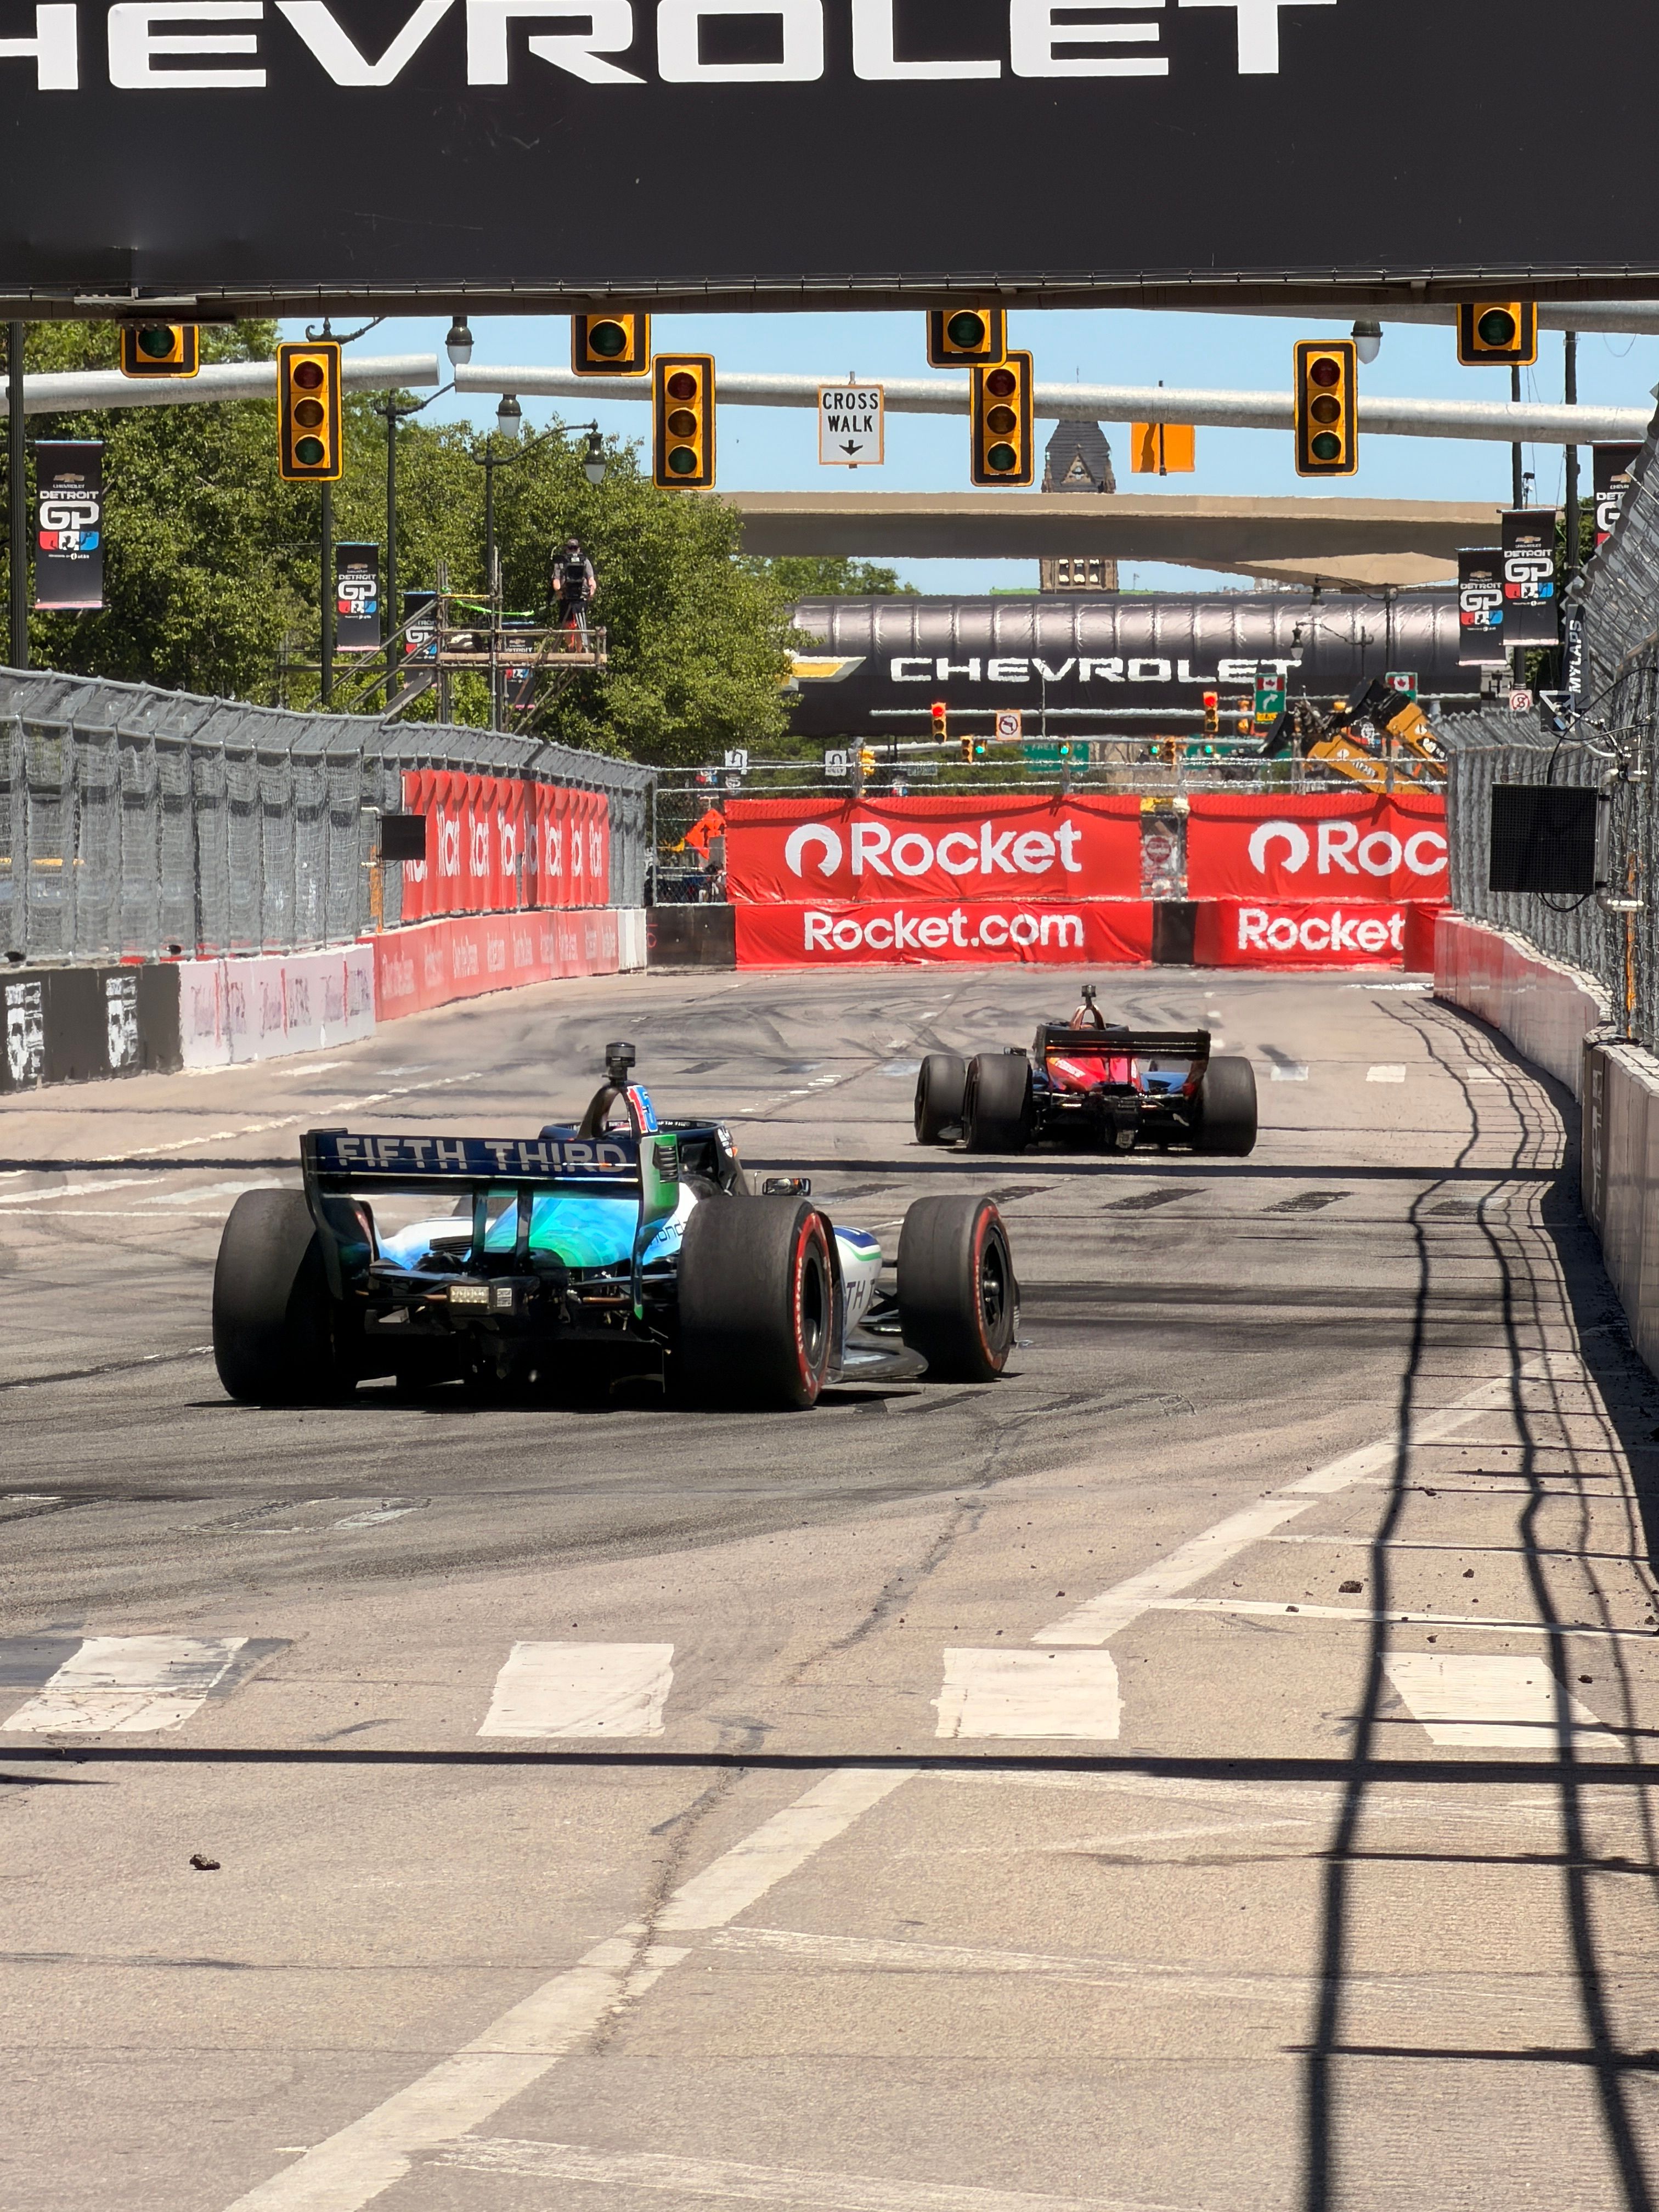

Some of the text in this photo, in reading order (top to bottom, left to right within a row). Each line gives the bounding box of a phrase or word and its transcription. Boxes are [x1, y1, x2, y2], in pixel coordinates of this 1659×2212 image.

[822, 392, 879, 410] CROSS
[827, 415, 873, 432] WALK
[40, 490, 99, 499] DETROIT
[40, 500, 100, 530] GP
[1504, 549, 1553, 558] DETROIT
[1505, 557, 1554, 582] GP
[338, 580, 377, 600] GP
[1460, 589, 1503, 612] GP
[1568, 619, 1582, 693] MYLAPS
[890, 657, 1302, 682] CHEVROLET
[851, 820, 1082, 877] Rocket
[1318, 820, 1448, 876] Roc
[804, 907, 1084, 951] Rocket.com
[336, 1138, 627, 1173] FIFTH THIRD
